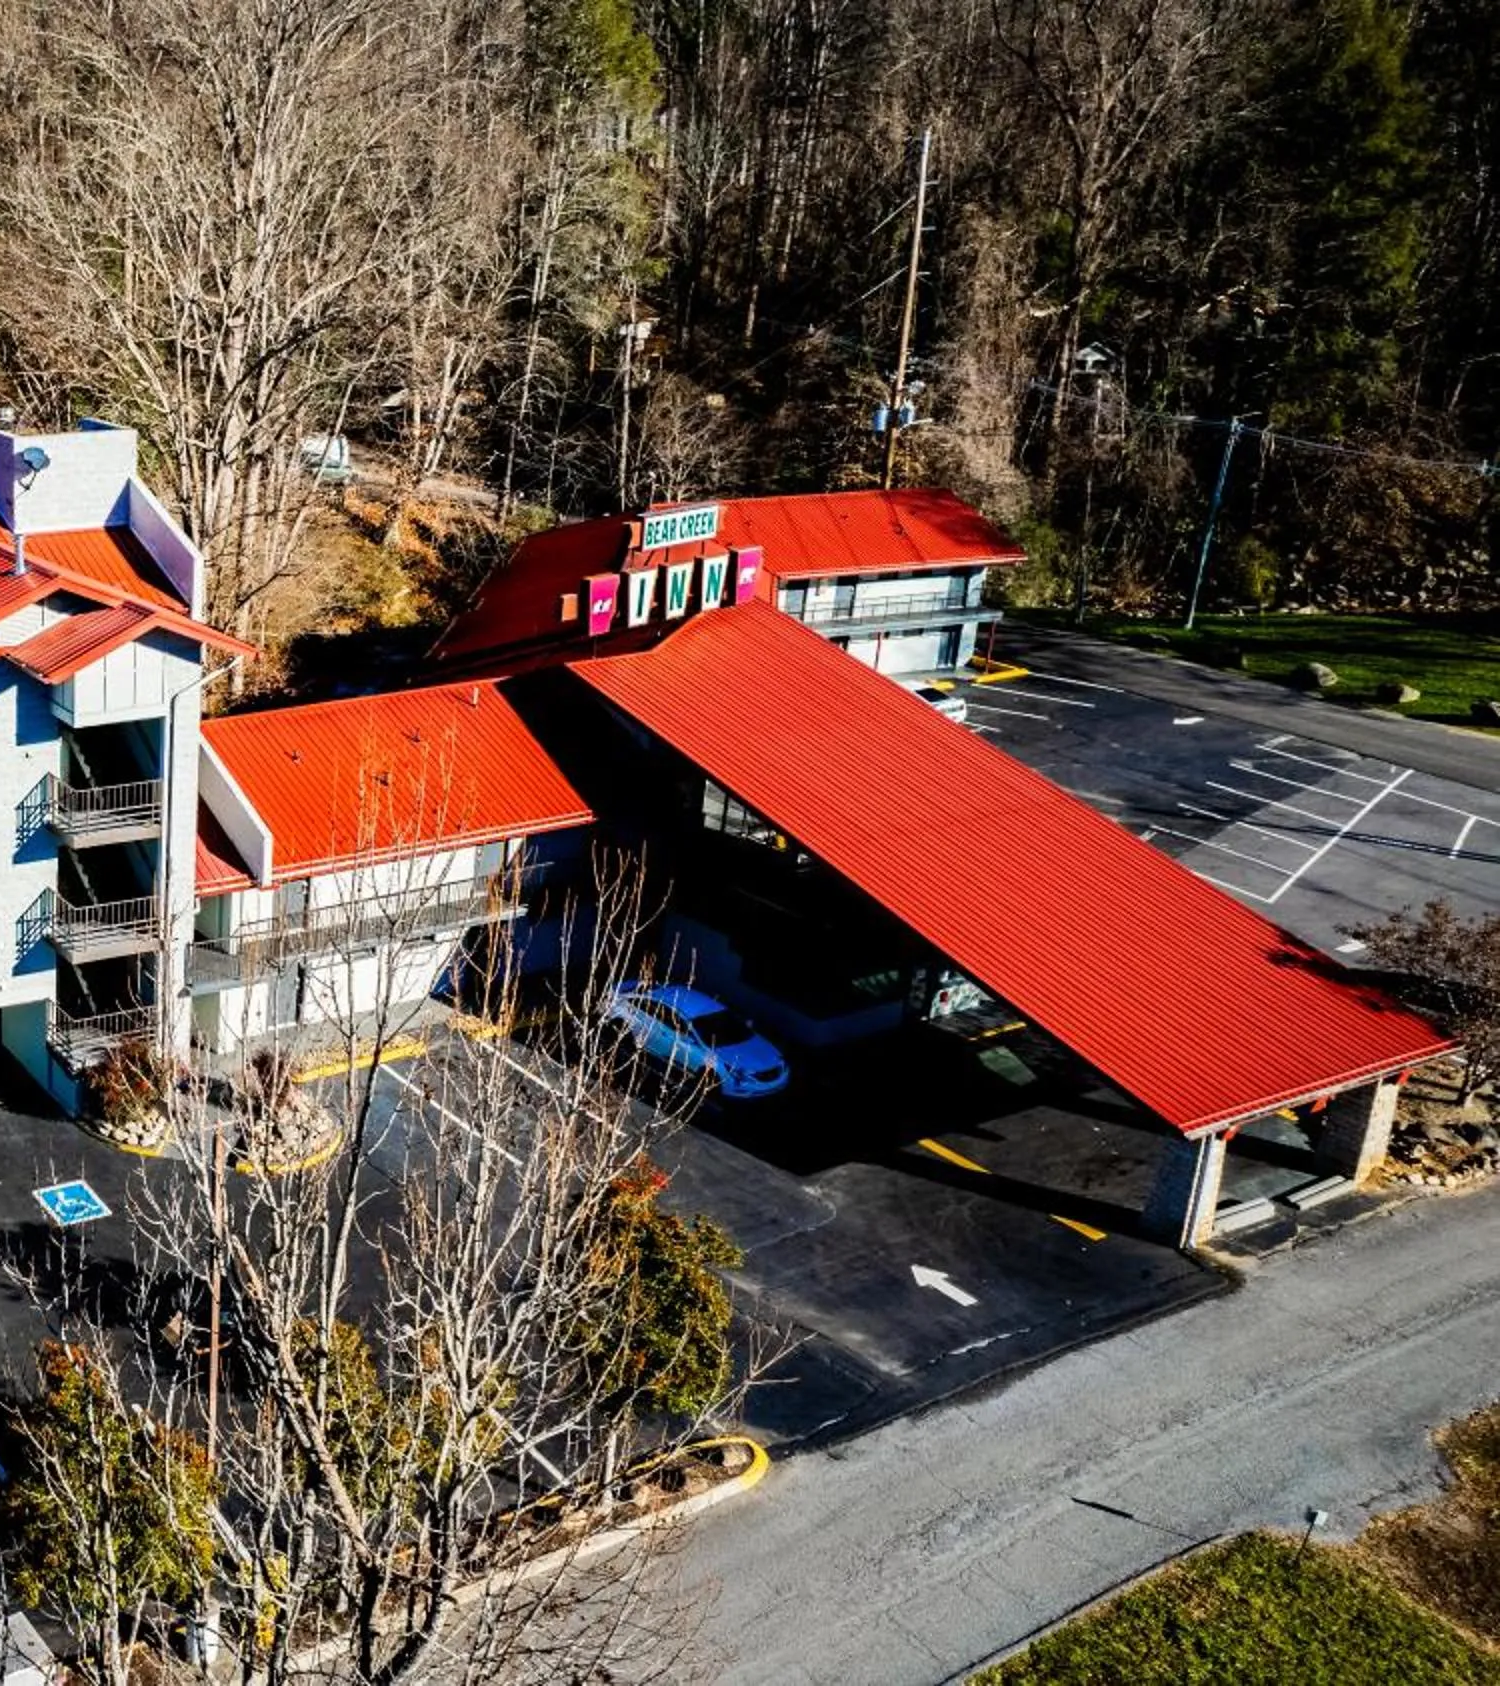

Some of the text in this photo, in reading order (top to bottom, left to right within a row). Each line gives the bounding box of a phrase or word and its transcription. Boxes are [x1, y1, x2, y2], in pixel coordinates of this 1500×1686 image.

[646, 511, 715, 546] BEAR CREEK
[637, 564, 723, 618] INN
